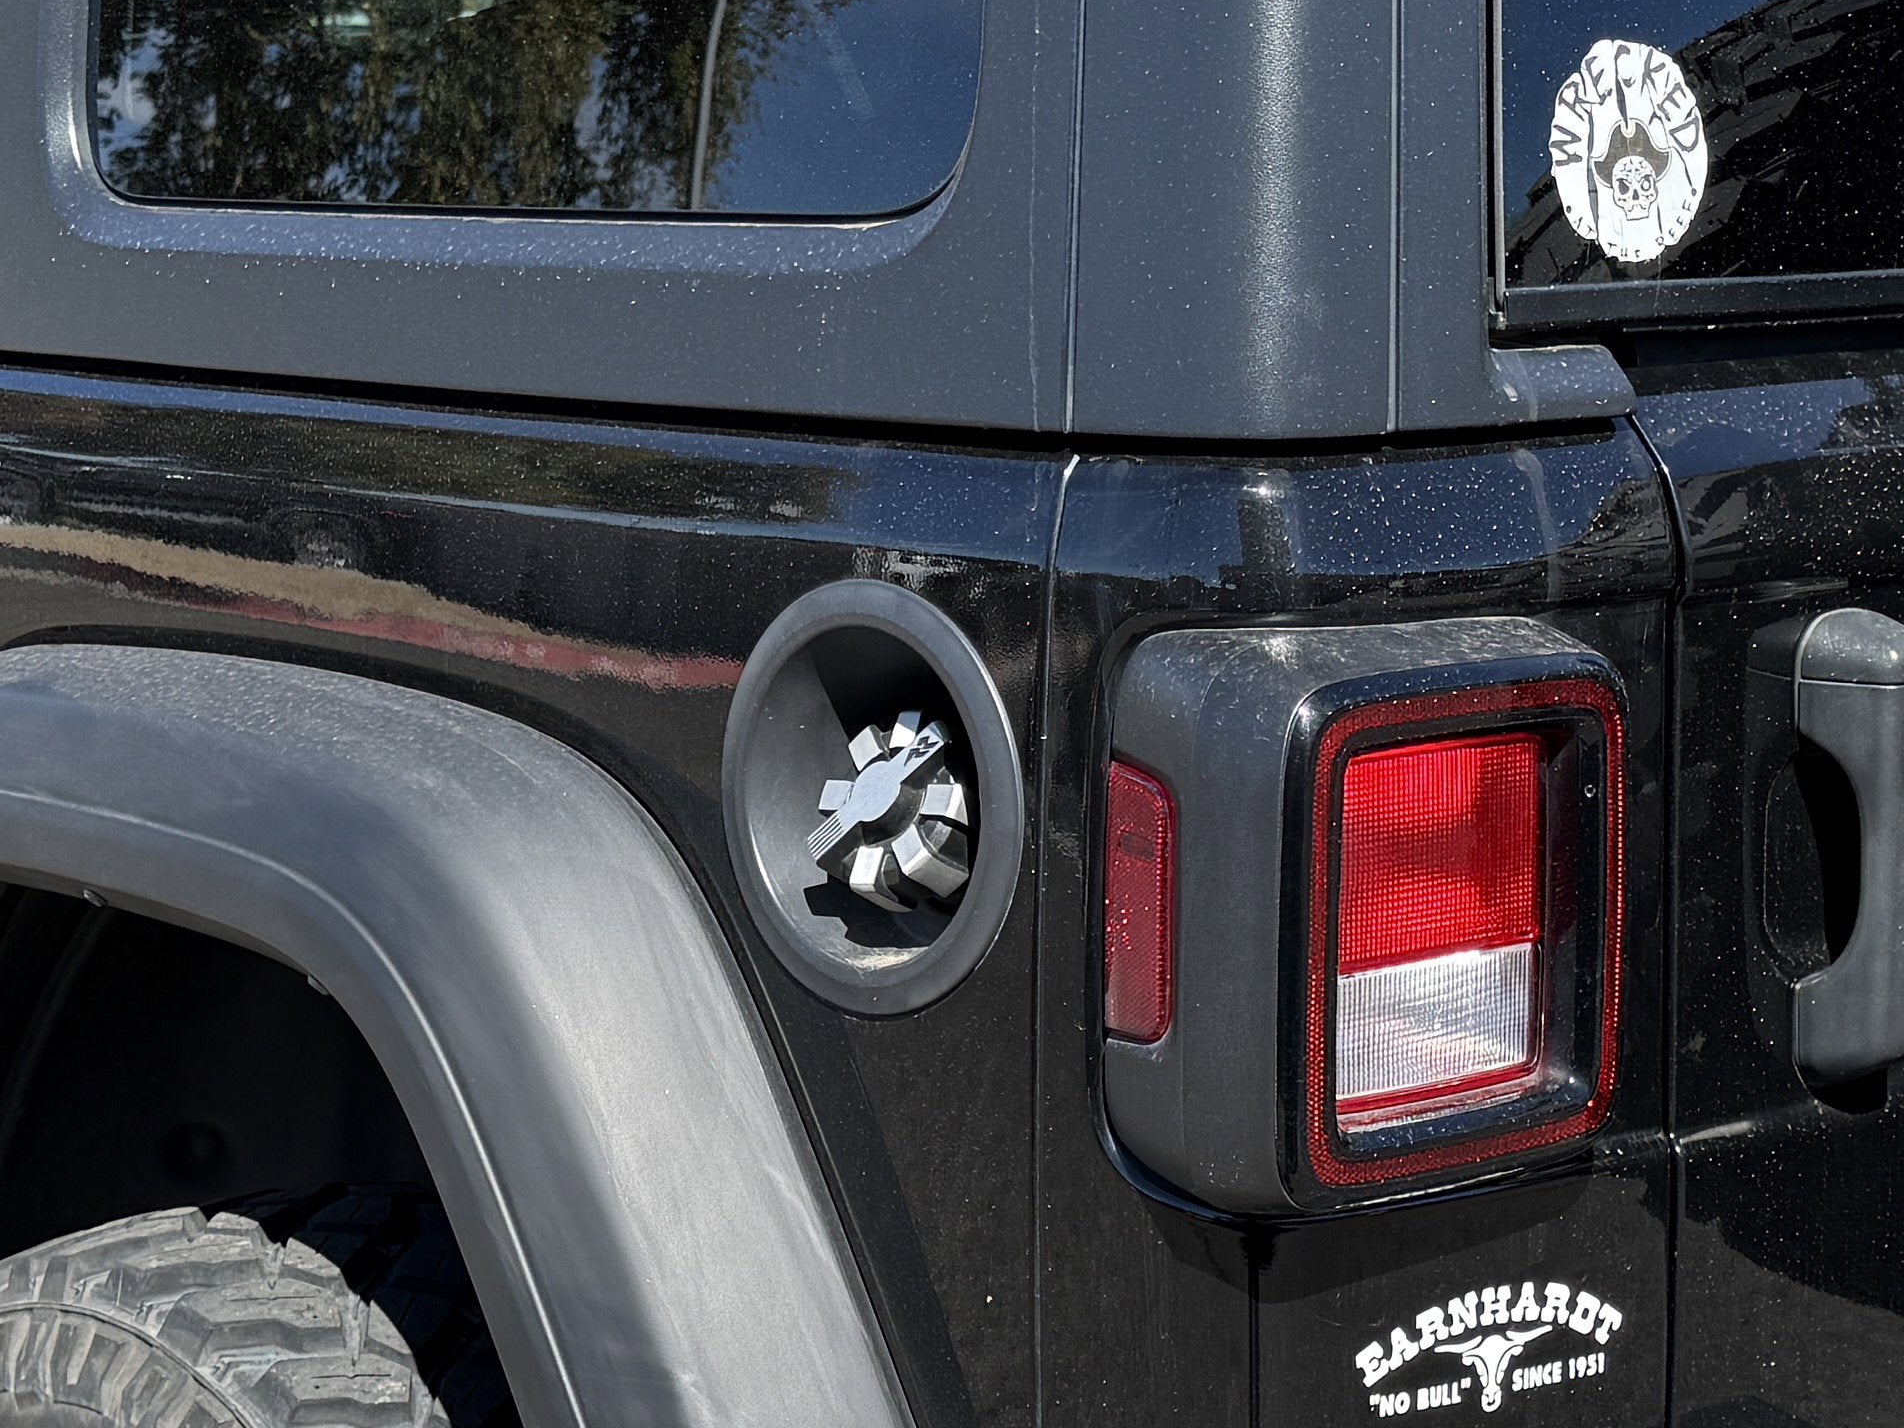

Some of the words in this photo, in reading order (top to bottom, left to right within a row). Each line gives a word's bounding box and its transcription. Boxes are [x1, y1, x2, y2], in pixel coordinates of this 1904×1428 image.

[1548, 44, 1700, 167] WRECKED
[1355, 1281, 1623, 1388] EARNHARDT
[1416, 1376, 1472, 1411] BULL"
[1512, 1361, 1563, 1392] SINCE
[1569, 1352, 1606, 1380] 1951
